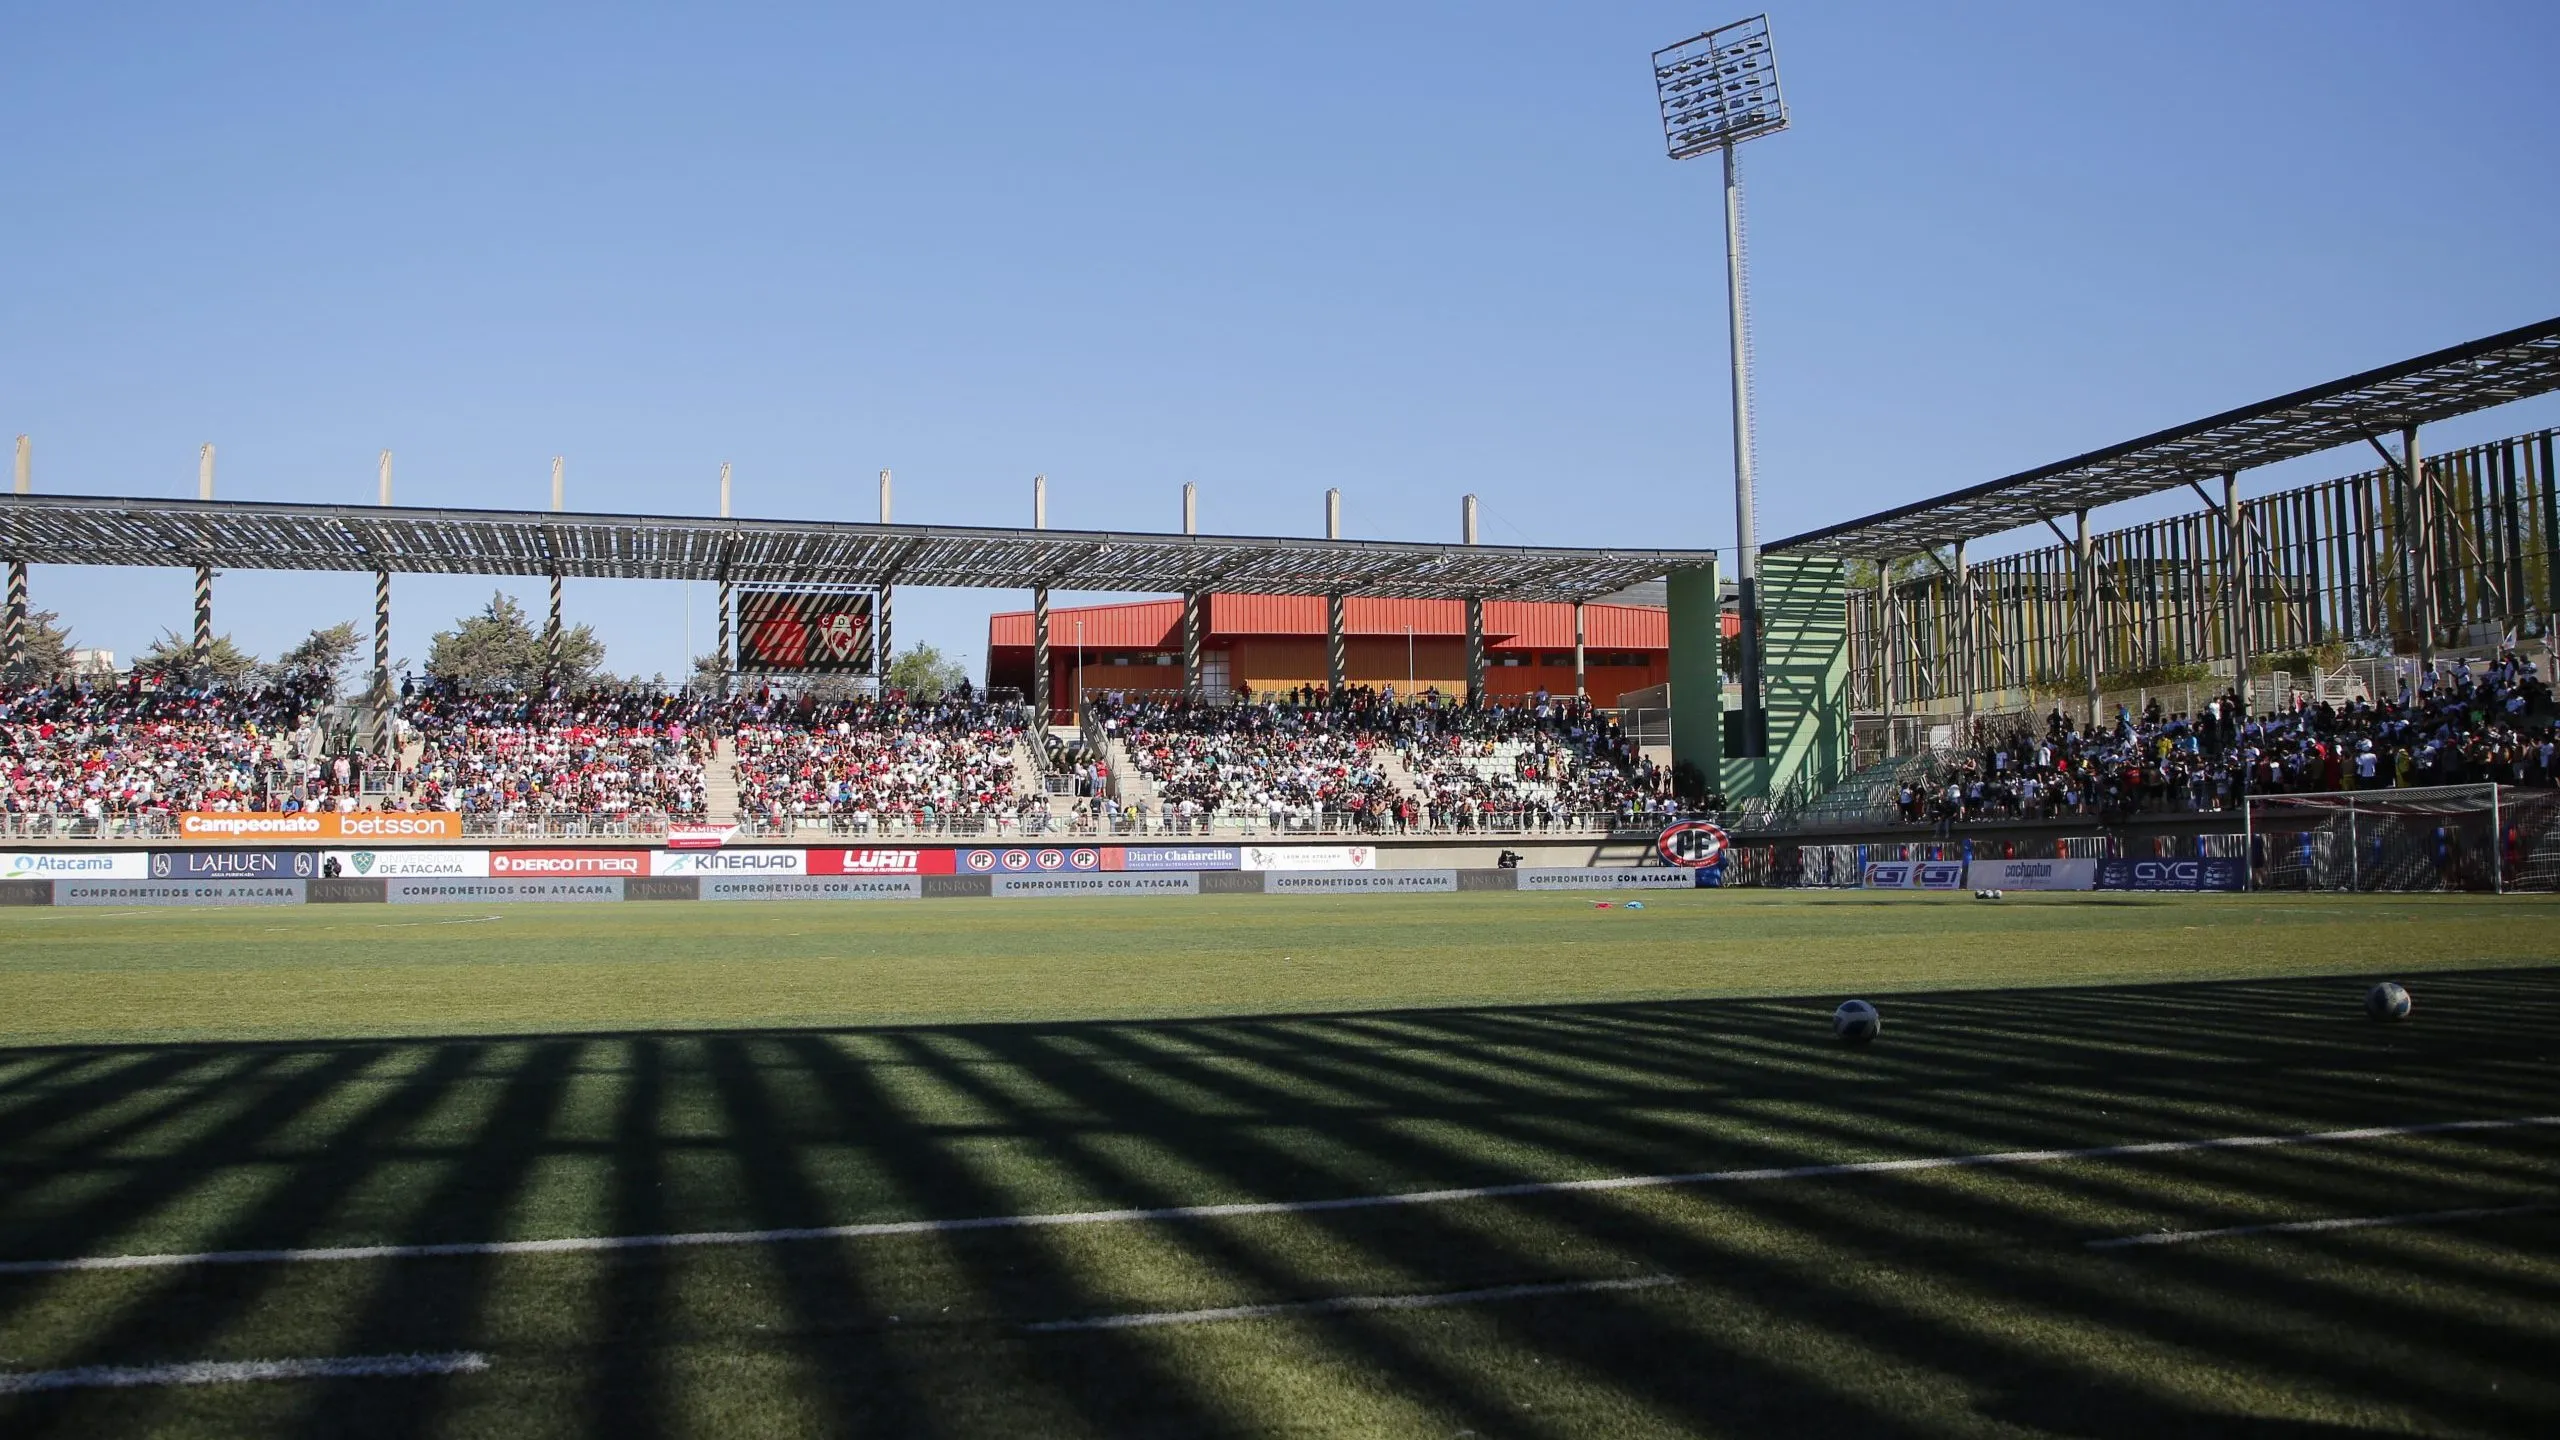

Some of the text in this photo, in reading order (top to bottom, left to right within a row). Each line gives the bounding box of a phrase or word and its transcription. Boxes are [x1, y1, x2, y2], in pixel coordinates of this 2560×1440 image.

[185, 815, 445, 835] Campeonato betsson
[1676, 829, 1712, 859] PF
[974, 854, 988, 866] PF
[1009, 854, 1023, 866] PF
[1043, 853, 1057, 865] PF
[1077, 853, 1091, 865] PF
[1128, 849, 1233, 862] Diario Chañarcillo
[36, 855, 113, 870] Atacama
[189, 853, 277, 872] LAHUEN
[380, 864, 463, 874] DE ATACAMA
[2135, 862, 2198, 879] GYG
[1005, 879, 1189, 890] COMPROMETIDOS CON ATACAMA
[1277, 877, 1448, 887] COMPROMETIDOS CON ATACAMA
[1529, 874, 1687, 884] COMPROMETIDOS CON ATACAMA
[70, 887, 293, 897] COMPROMETIDOS CON ATACAMA
[314, 885, 379, 897] KINROSS
[402, 885, 612, 895] COMPROMETIDOS CON ATACAMA
[632, 883, 692, 896] KINROSS
[715, 883, 911, 892] COMPROMETIDOS CON ATACAMA
[928, 880, 985, 892] KINROSS
